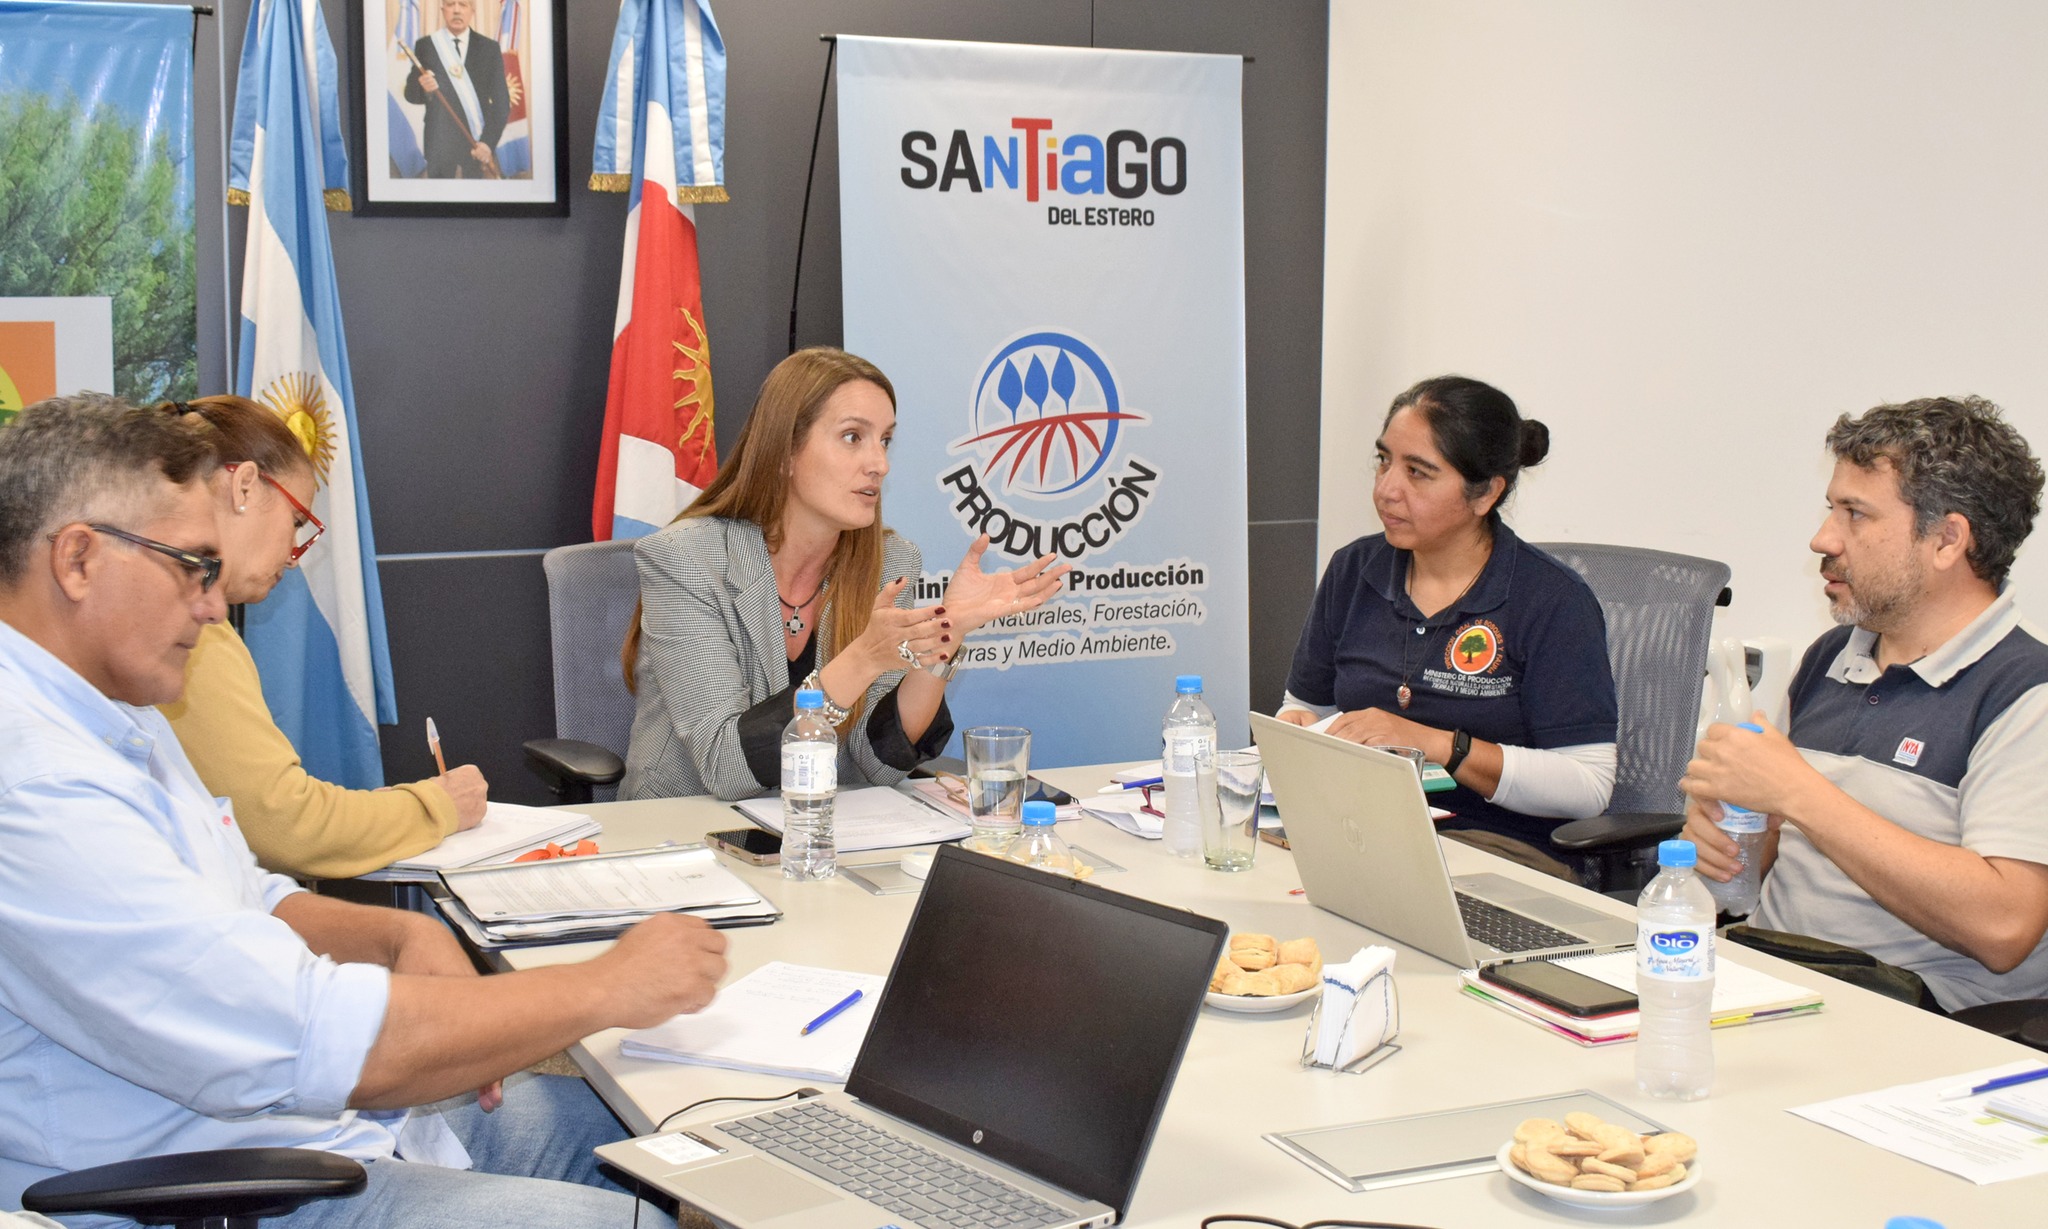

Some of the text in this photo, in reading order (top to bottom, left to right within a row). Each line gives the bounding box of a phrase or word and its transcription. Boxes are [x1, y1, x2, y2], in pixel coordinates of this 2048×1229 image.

[942, 460, 1157, 560] PRODUCCIÓN
[1069, 563, 1204, 591] Producción
[1093, 598, 1203, 622] Forestación,
[1001, 646, 1014, 664] y
[1018, 638, 1075, 659] Medio
[1080, 634, 1172, 655] Ambiente.
[1424, 668, 1457, 680] MINISTERIO
